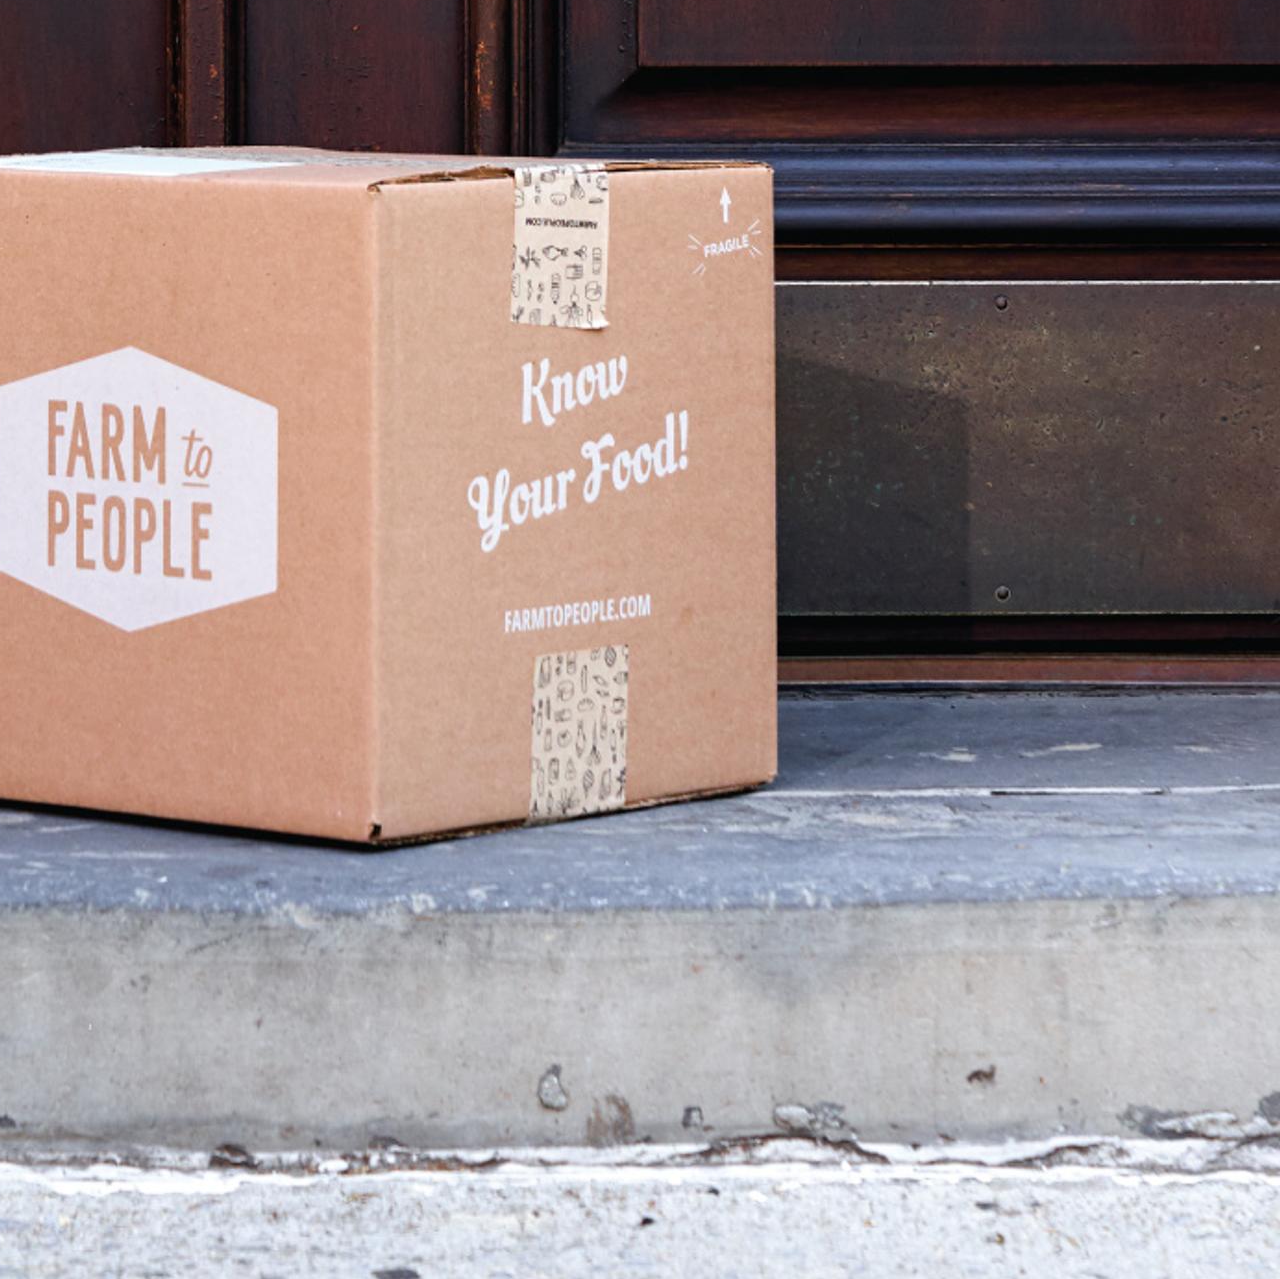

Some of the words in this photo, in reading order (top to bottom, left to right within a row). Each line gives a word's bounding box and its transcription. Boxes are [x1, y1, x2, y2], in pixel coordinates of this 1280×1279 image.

[703, 233, 750, 258] FRAGILE
[521, 355, 628, 427] Know
[47, 398, 167, 485] FARM
[181, 429, 213, 479] to
[467, 468, 576, 553] Your
[581, 410, 689, 503] Food!
[47, 489, 213, 581] PEOPLE
[504, 593, 652, 634] FARMTOPEOPLE.COM
